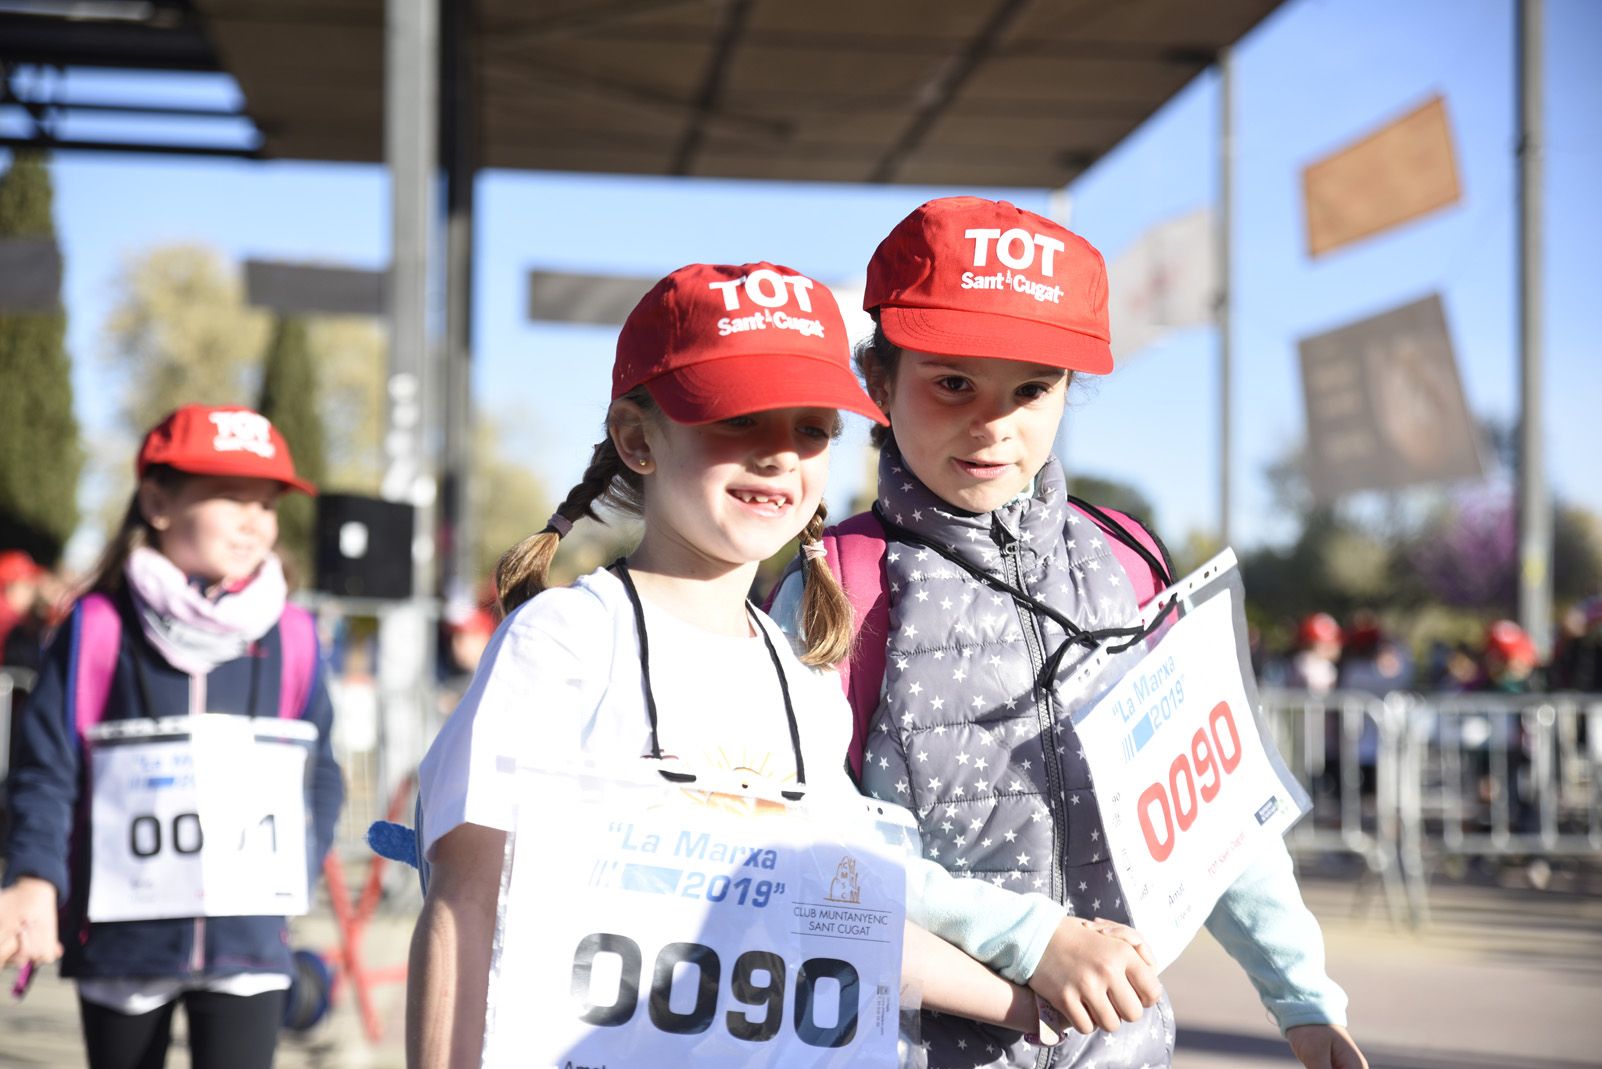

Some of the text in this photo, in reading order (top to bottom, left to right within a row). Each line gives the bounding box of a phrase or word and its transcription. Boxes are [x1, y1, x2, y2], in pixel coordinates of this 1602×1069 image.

[964, 228, 1065, 277] TOT
[708, 269, 814, 313] TOT
[961, 271, 1064, 304] Sant Cugat
[717, 311, 825, 338] Sant Cugat
[1133, 655, 1176, 705] Marxa
[1137, 700, 1243, 863] 0090
[130, 813, 279, 860] 001
[674, 830, 778, 871] Marxa
[793, 906, 888, 926] CLUB MUNTANYENC
[808, 921, 872, 936] SANT CUGAT
[570, 932, 861, 1049] 0090
